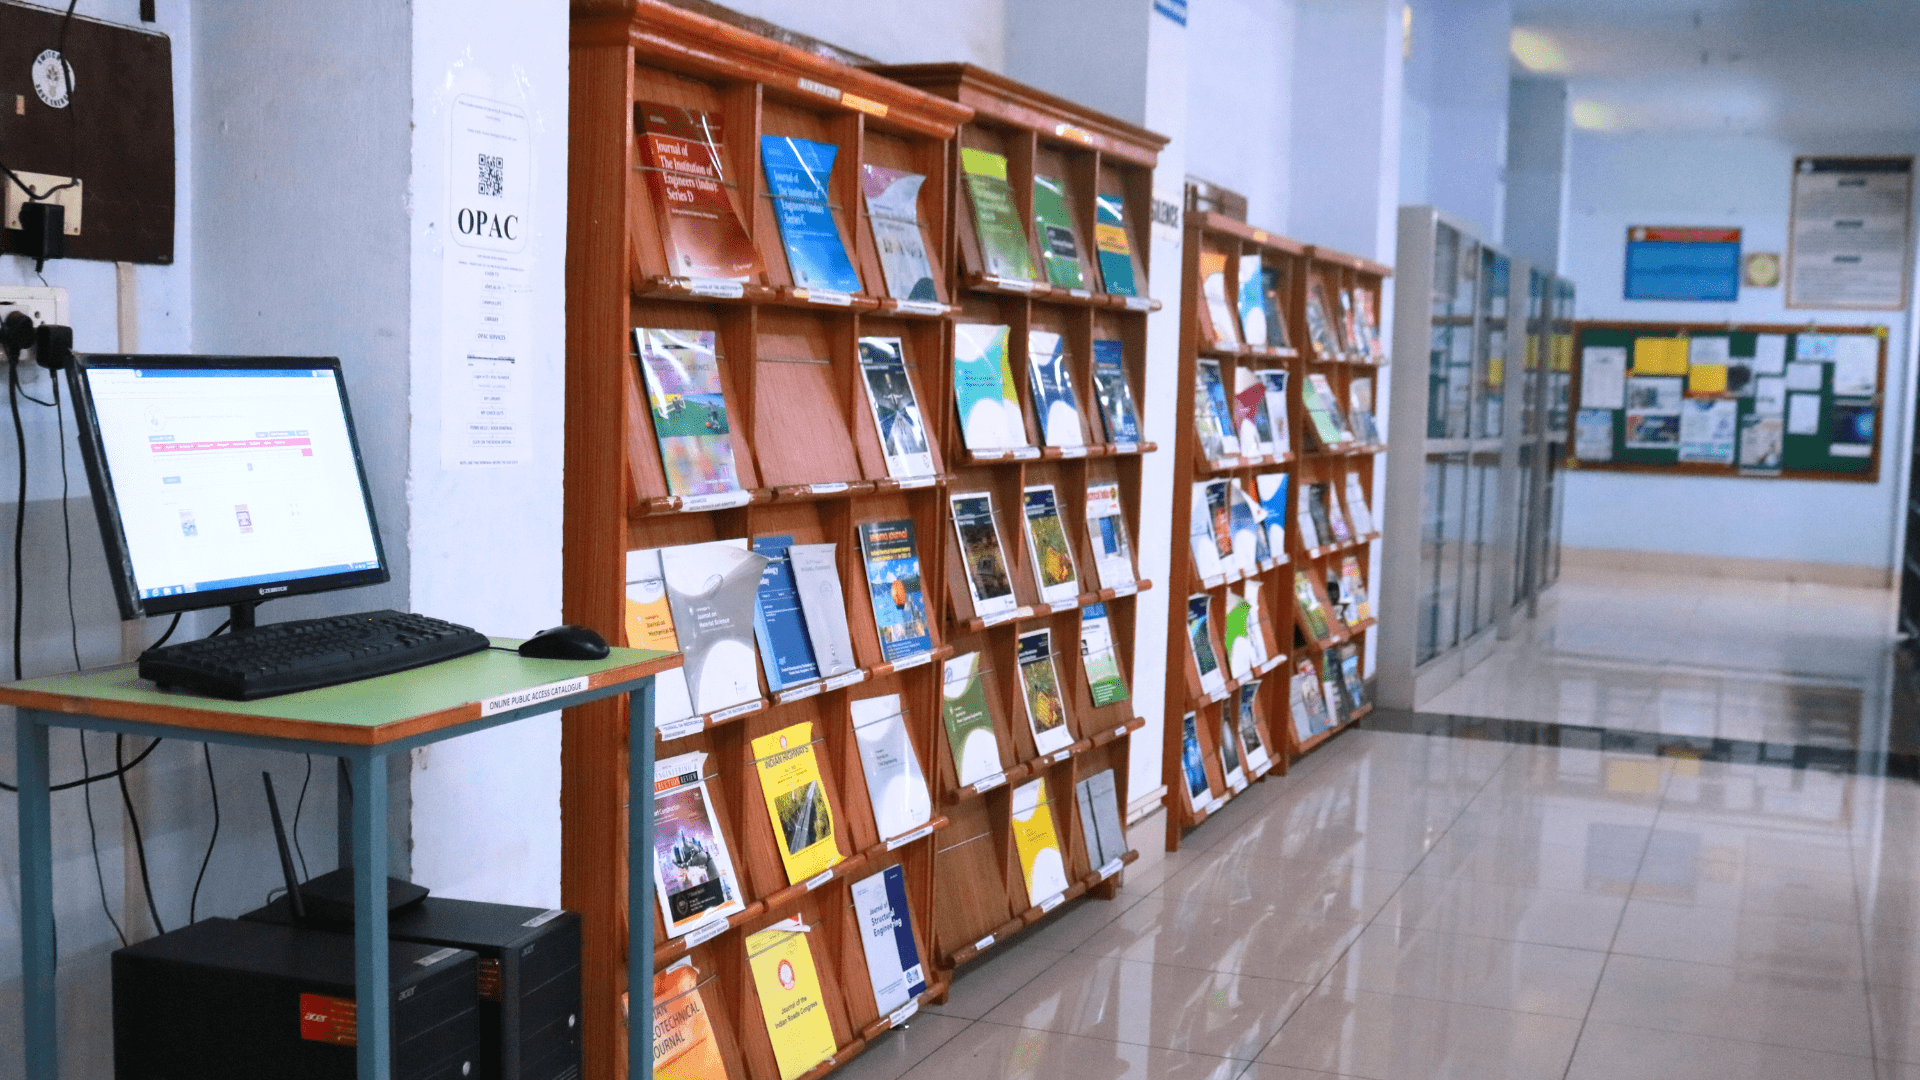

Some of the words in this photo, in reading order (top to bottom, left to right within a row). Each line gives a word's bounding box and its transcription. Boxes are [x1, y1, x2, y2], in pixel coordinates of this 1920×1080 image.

[655, 139, 681, 155] Journal
[681, 144, 688, 156] of
[658, 155, 673, 169] The
[673, 157, 706, 175] Institution
[706, 164, 713, 177] of
[663, 171, 695, 189] Engineers
[773, 169, 793, 183] Journal
[667, 187, 687, 202] Series
[687, 190, 694, 203] D
[777, 183, 787, 196] The
[787, 185, 813, 199] Institution
[784, 212, 801, 225] Series
[1151, 200, 1178, 228] SILENCE
[458, 208, 518, 240] OPAC
[489, 698, 510, 710] ONLINE
[511, 693, 530, 705] PUBLIC
[531, 689, 551, 700] ACCESS
[550, 682, 582, 695] CATALOGUE
[765, 755, 783, 769] INDIAN
[782, 745, 809, 761] HIGHWAYS
[655, 765, 691, 780] ENGINEERING
[680, 772, 698, 784] REVIEW
[869, 905, 884, 915] Journal
[871, 907, 896, 926] Structural
[873, 917, 903, 937] Engineering
[521, 943, 535, 957] acer
[398, 986, 416, 1001] acer
[774, 1017, 788, 1029] Indian
[787, 1011, 800, 1022] Roads
[800, 1001, 818, 1015] Congress
[781, 1001, 796, 1015] Journal
[795, 998, 801, 1006] of
[304, 1012, 327, 1022] acer
[653, 1030, 686, 1059] OURNAL
